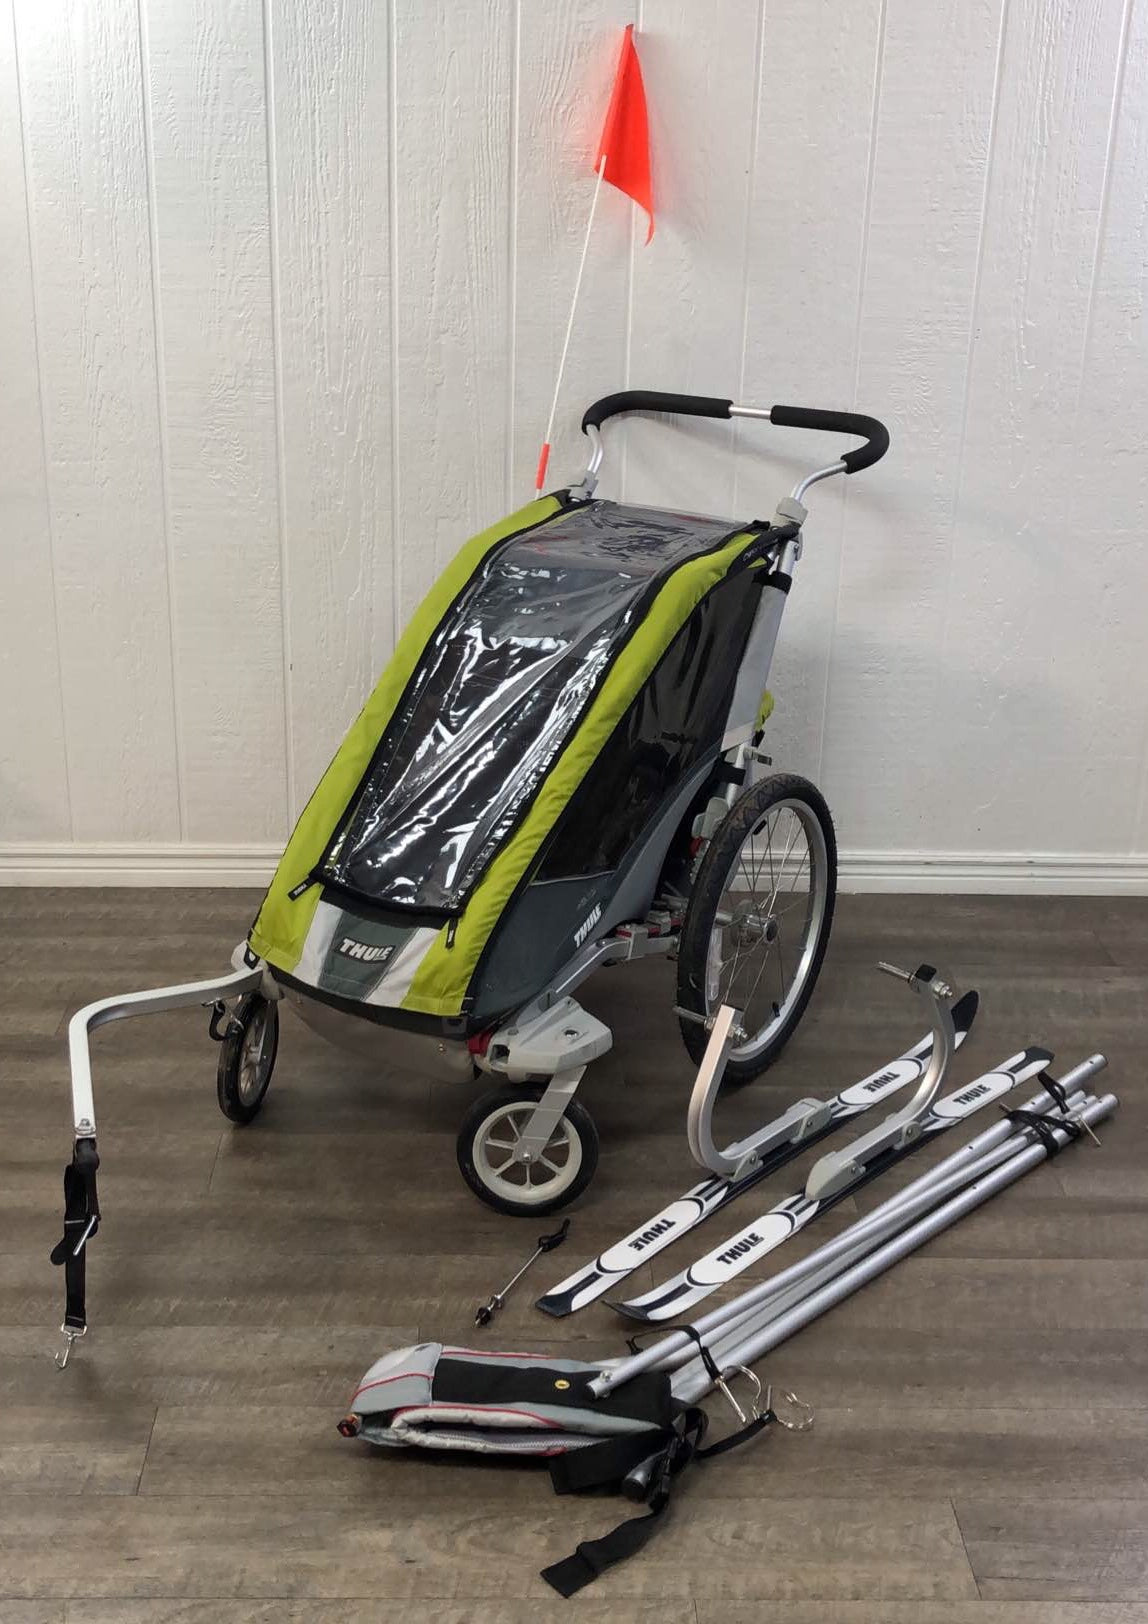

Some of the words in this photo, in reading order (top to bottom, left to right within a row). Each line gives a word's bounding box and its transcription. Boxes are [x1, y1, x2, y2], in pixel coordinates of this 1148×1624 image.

[574, 902, 602, 948] THULE
[339, 938, 393, 961] THULE
[863, 1071, 900, 1093] THULE
[953, 1084, 991, 1105] THULE
[628, 1218, 676, 1251] THULE
[716, 1232, 765, 1265] THULE
